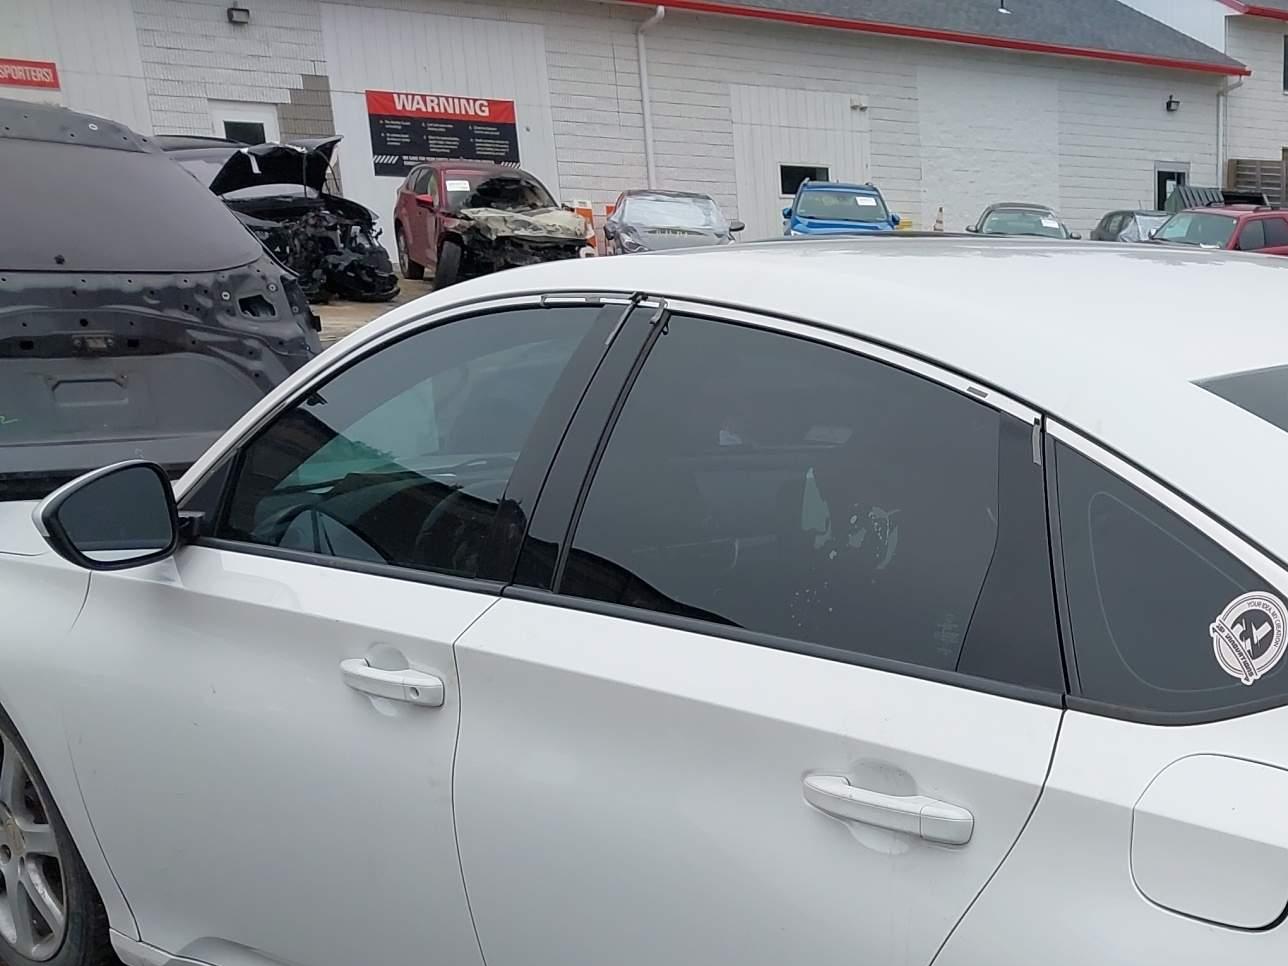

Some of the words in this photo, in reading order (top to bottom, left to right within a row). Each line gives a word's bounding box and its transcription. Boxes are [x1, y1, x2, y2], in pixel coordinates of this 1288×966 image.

[393, 94, 489, 116] WARNING
[1247, 601, 1261, 609] YOUR
[1273, 619, 1282, 648] CREATION
